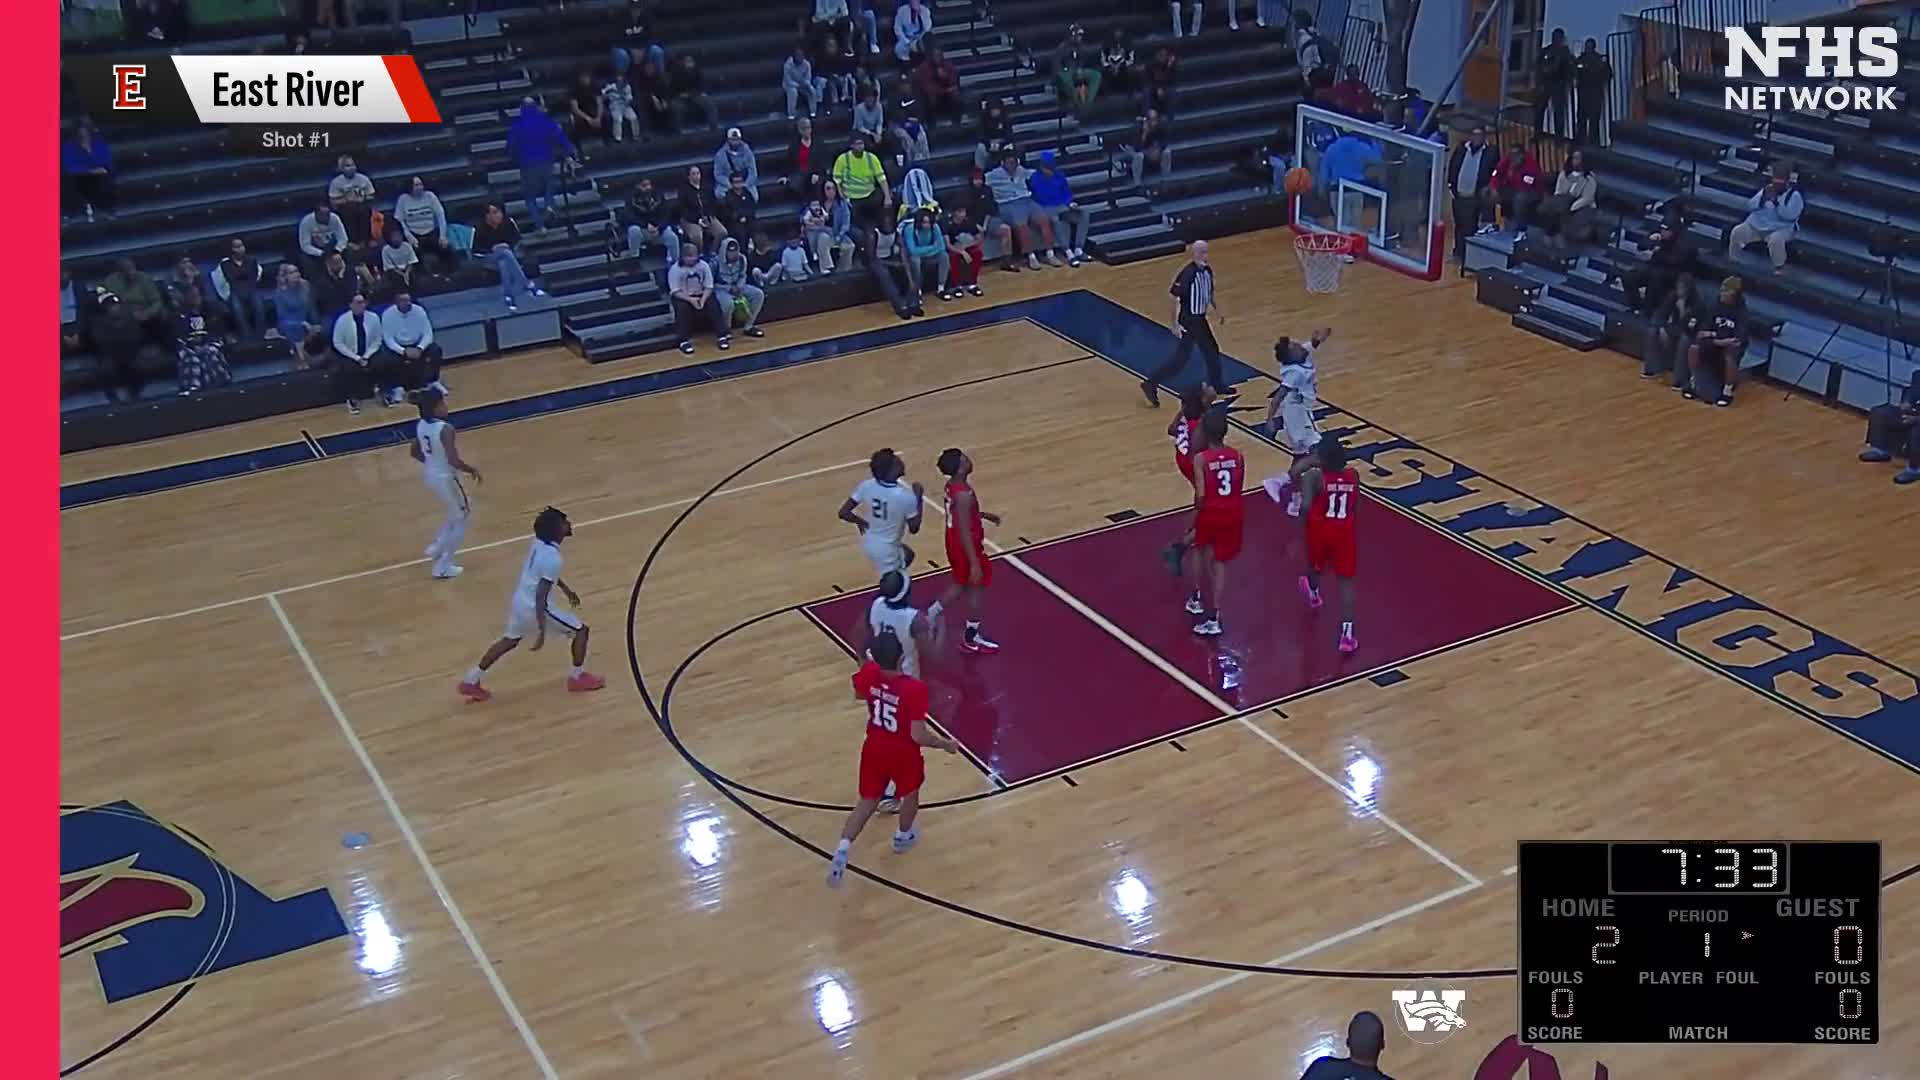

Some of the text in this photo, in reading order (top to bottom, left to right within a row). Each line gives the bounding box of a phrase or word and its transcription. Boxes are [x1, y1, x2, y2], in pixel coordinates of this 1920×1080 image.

[1216, 470, 1232, 496] 3
[872, 498, 888, 520] 21
[1325, 492, 1349, 519] 11
[872, 698, 898, 732] 15
